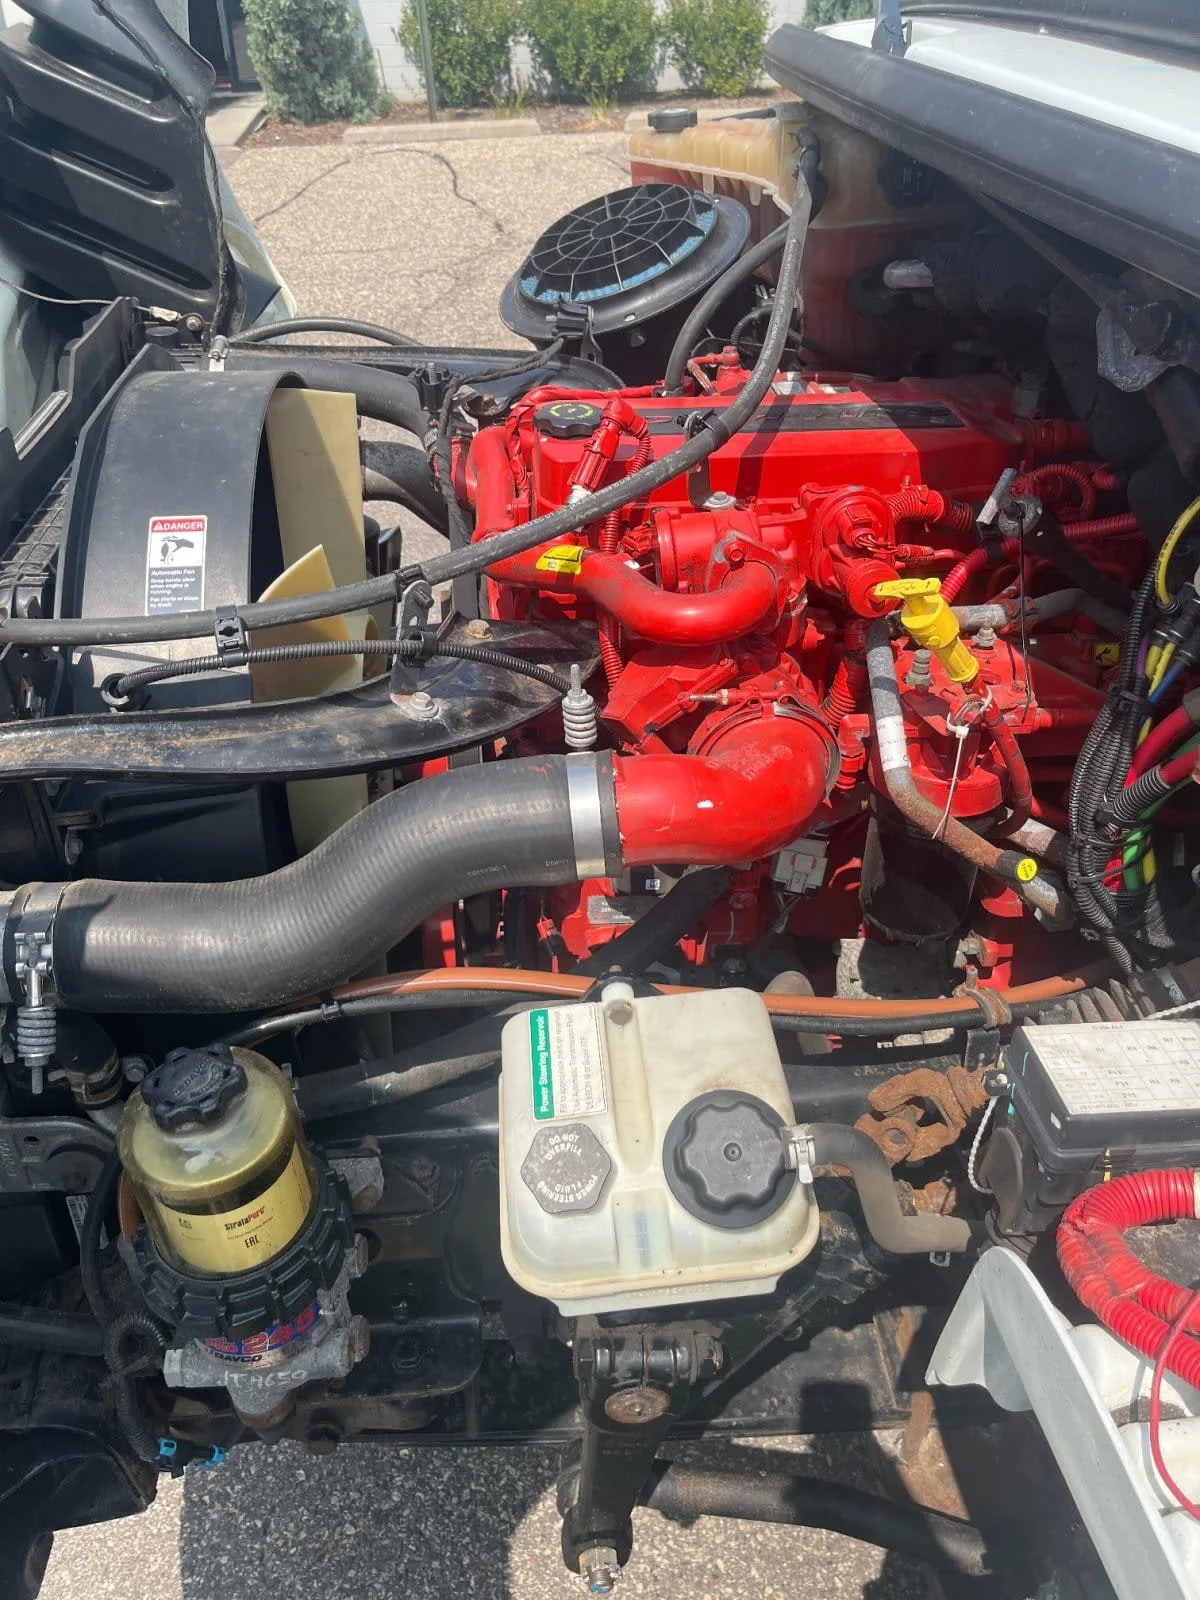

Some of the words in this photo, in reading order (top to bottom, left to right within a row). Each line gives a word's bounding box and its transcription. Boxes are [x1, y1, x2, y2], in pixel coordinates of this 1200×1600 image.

[163, 522, 203, 530] DANGER
[536, 1015, 545, 1051] Reservoir
[568, 1028, 577, 1066] Transmission
[539, 1052, 548, 1085] Steering
[571, 1067, 579, 1097] Automatic
[540, 1087, 549, 1112] Power
[549, 1135, 561, 1145] DO
[561, 1132, 580, 1143] NOT
[545, 1142, 583, 1160] OVERFILL
[537, 1181, 575, 1203] STEERING
[554, 1180, 582, 1193] FLUID
[575, 1174, 599, 1201] POWER
[214, 1351, 263, 1362] DAVCO
